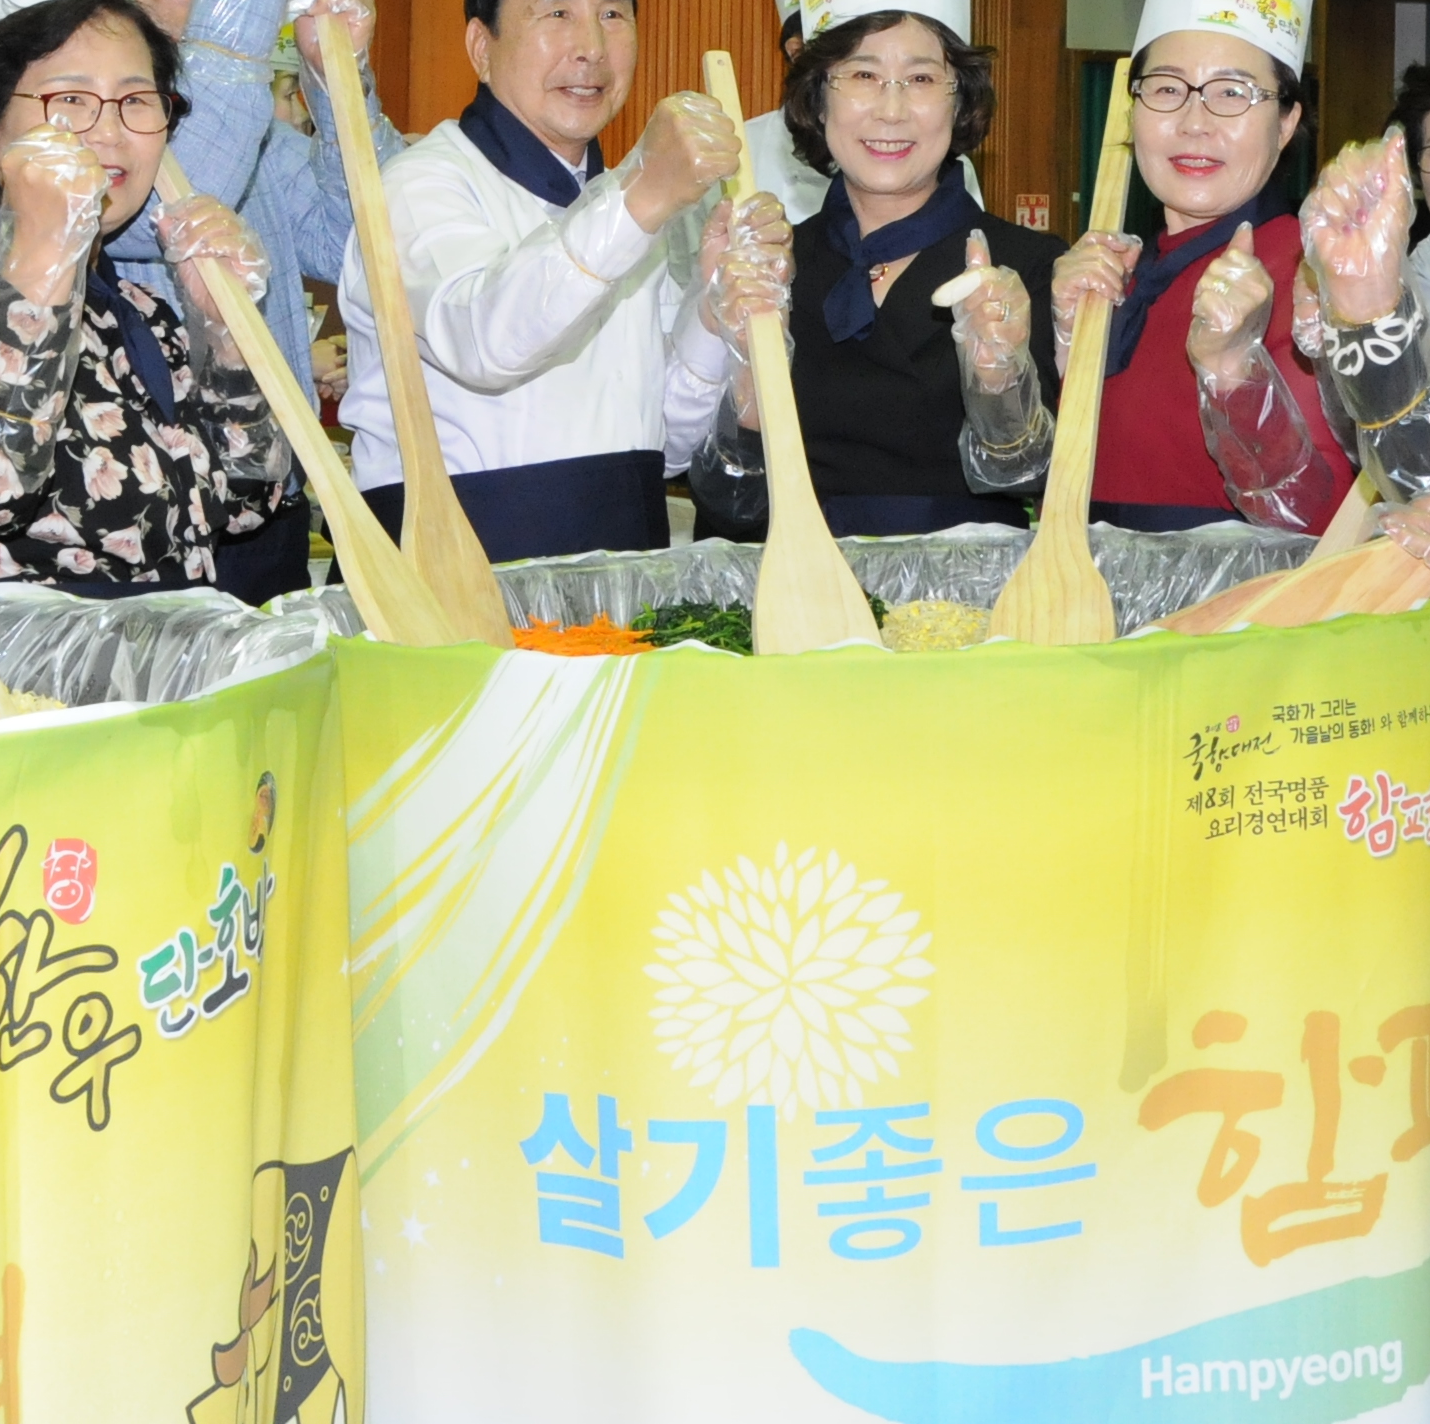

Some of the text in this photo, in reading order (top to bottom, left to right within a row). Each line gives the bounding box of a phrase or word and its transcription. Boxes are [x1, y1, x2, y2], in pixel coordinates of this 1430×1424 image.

[1271, 698, 1357, 723] 국화가 그리는
[1291, 724, 1344, 745] 가을날의
[1348, 718, 1376, 739] 동화!
[1380, 713, 1393, 731] 와
[1184, 775, 1330, 816] 제8회 전국명품
[1204, 803, 1329, 840] 요리경연대회
[518, 1091, 1097, 1268] 살기좋은
[1140, 1339, 1403, 1402] Hampyeong
